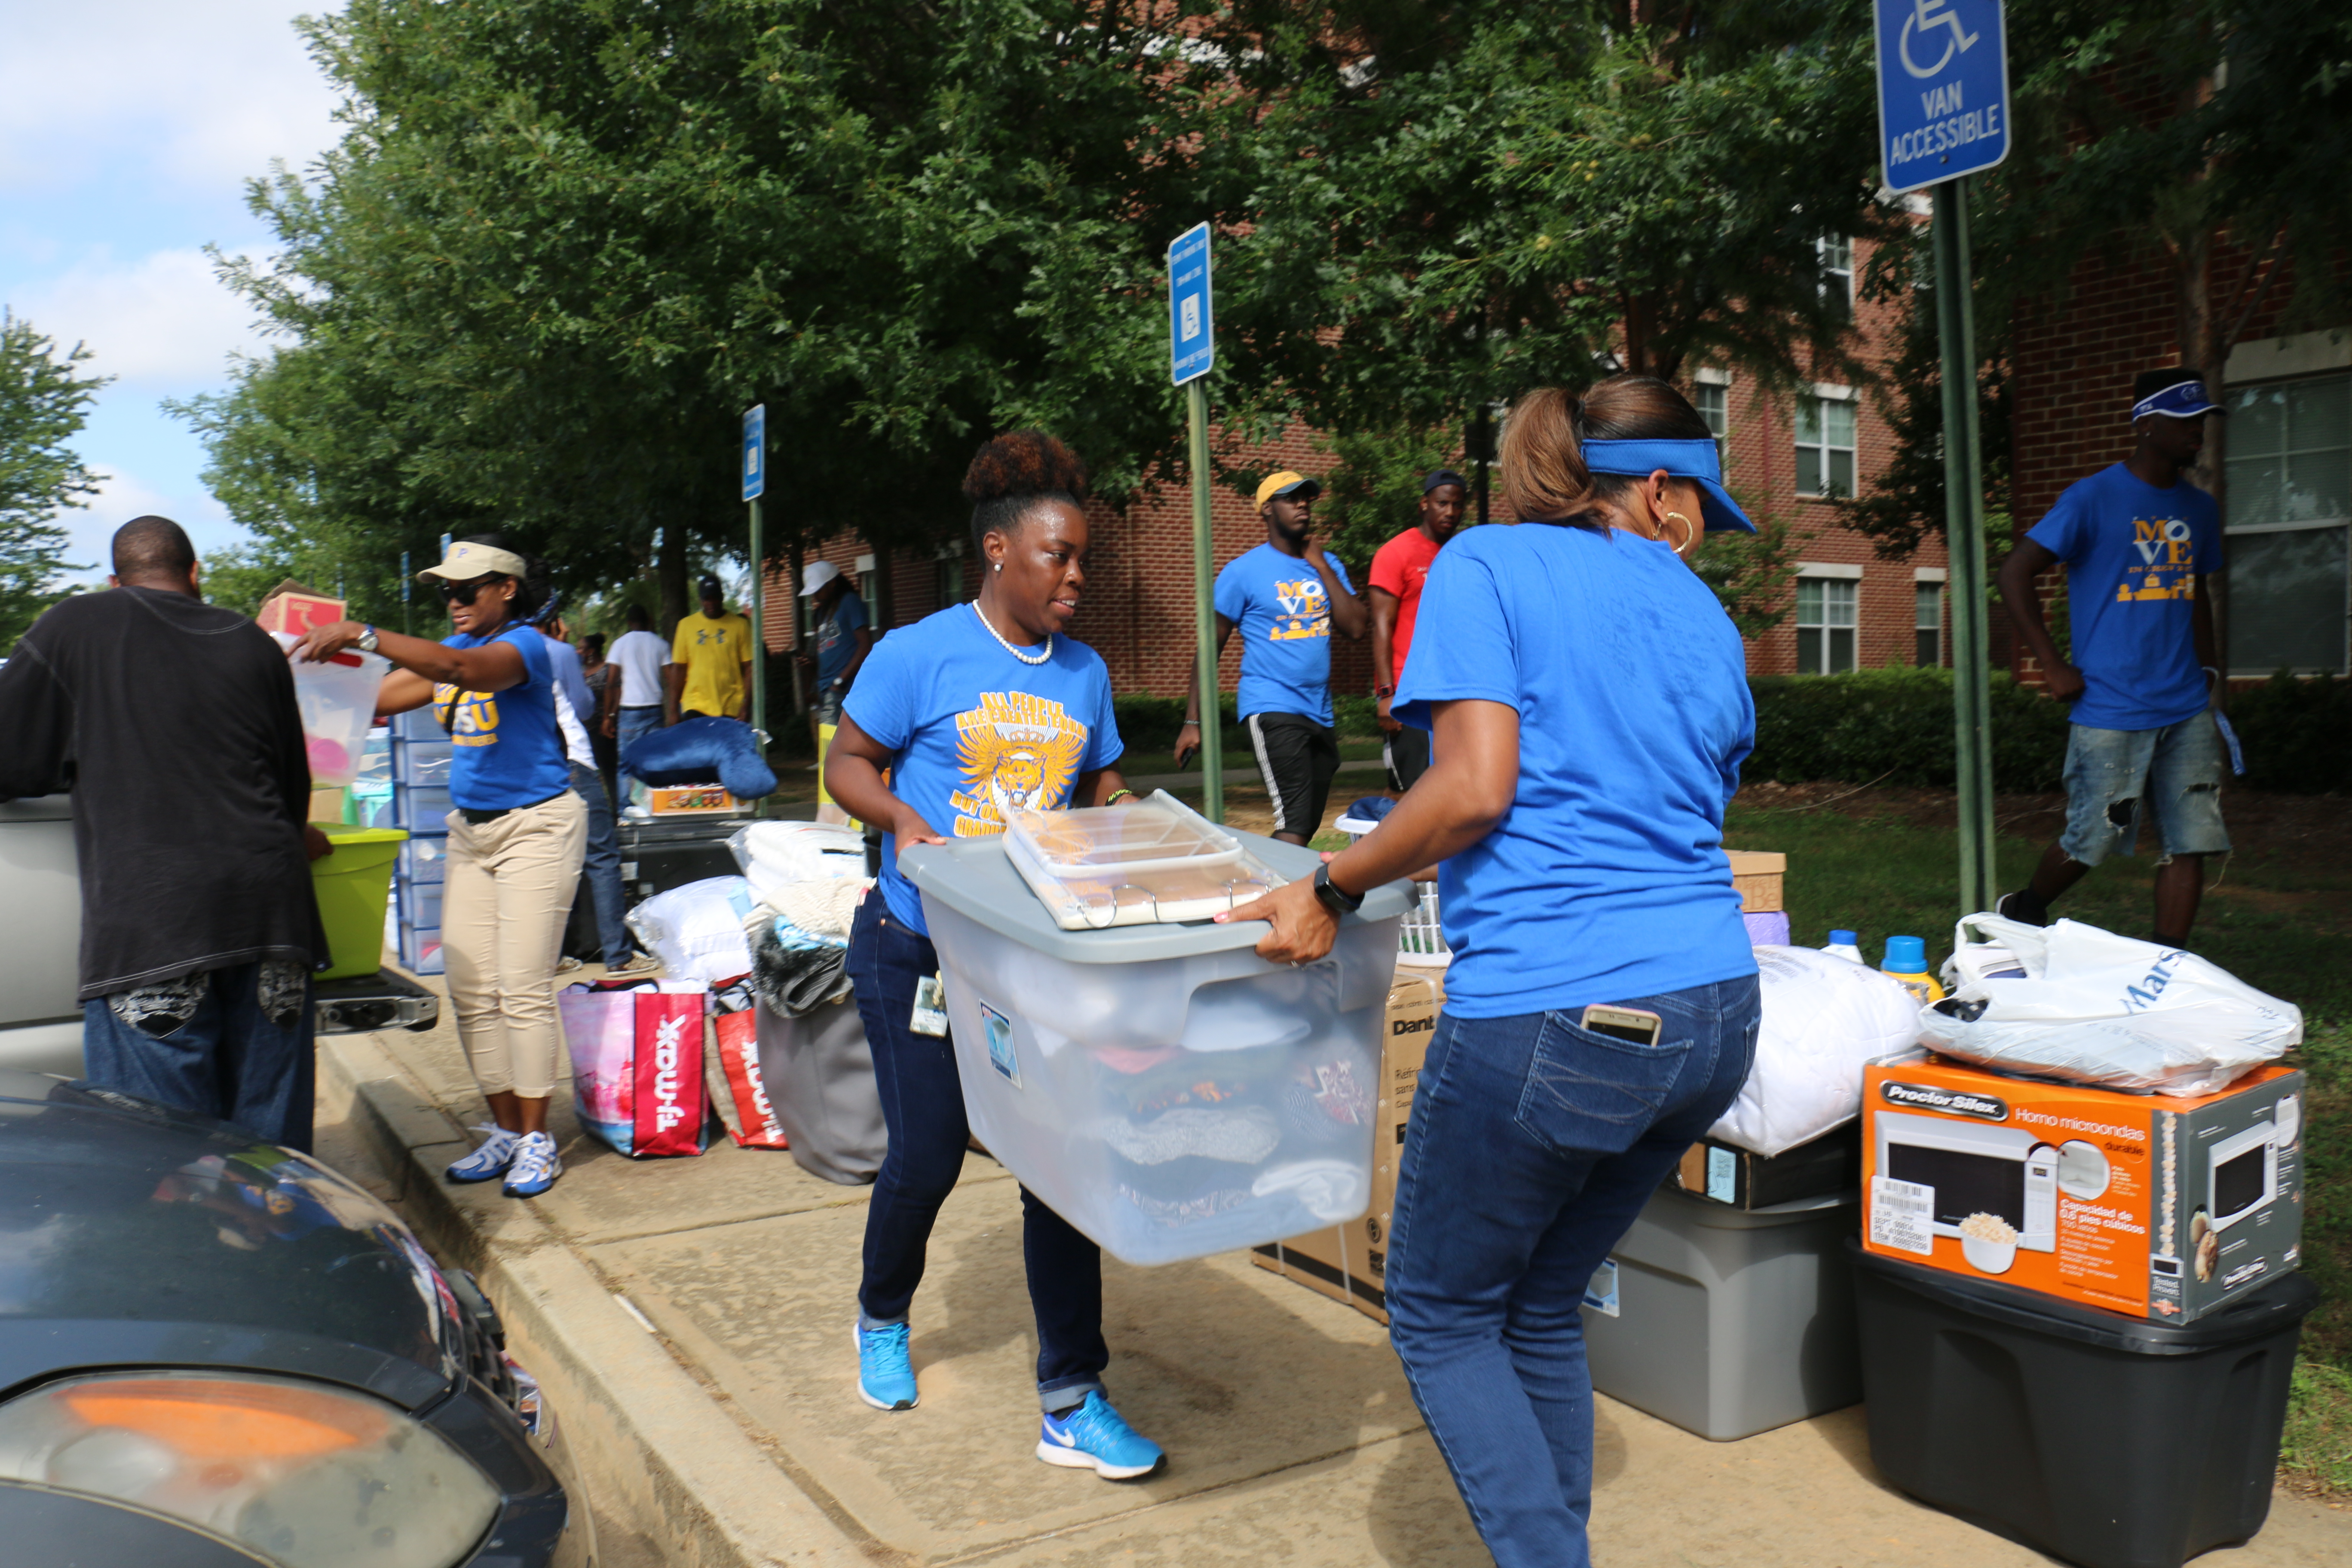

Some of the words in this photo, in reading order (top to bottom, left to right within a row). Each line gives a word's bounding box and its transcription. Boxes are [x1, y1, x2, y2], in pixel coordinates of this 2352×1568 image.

[1921, 80, 1963, 121] VAN
[1890, 103, 2000, 167] ACCESSIBLE
[980, 692, 1008, 711] ALL
[1009, 691, 1063, 717] PEOPLE
[955, 710, 987, 731] ARE
[987, 709, 1049, 726] CREATED
[949, 789, 981, 817] BUT
[2015, 1108, 2058, 1126] Horno
[2059, 1118, 2146, 1141] microondas
[2105, 1142, 2145, 1156] durable
[2059, 1208, 2077, 1220] 0.6
[2078, 1213, 2102, 1225] pies
[2102, 1218, 2145, 1234] cúbicos
[2060, 1198, 2116, 1218] Capacidad
[2117, 1210, 2133, 1222] de
[2061, 1219, 2076, 1229] 700
[2077, 1225, 2098, 1234] vatios
